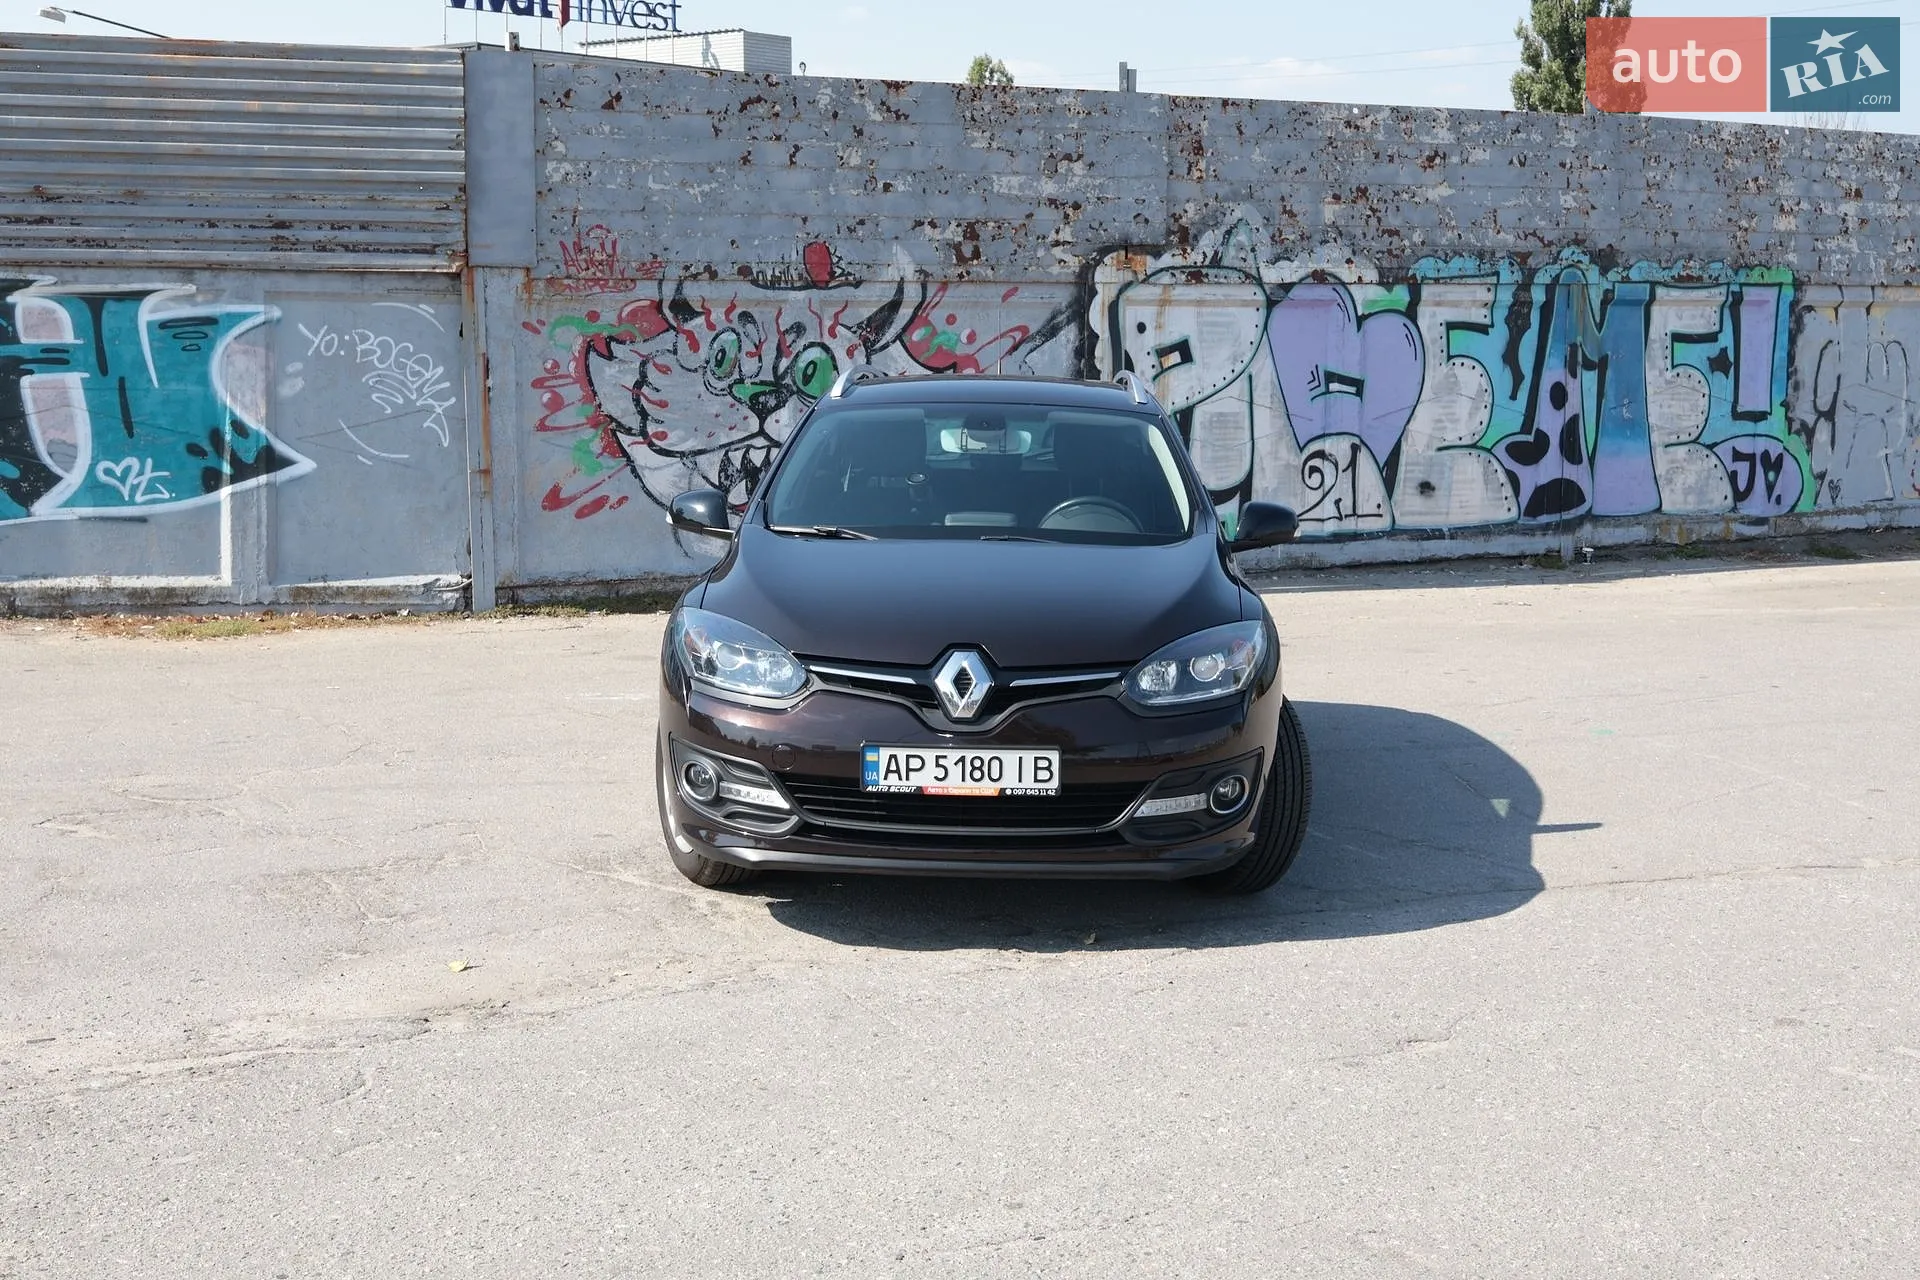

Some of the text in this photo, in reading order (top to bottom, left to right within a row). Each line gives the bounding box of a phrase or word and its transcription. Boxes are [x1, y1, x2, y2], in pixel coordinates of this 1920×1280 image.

[865, 771, 878, 780] UA
[883, 753, 1054, 784] AP 5180 IB
